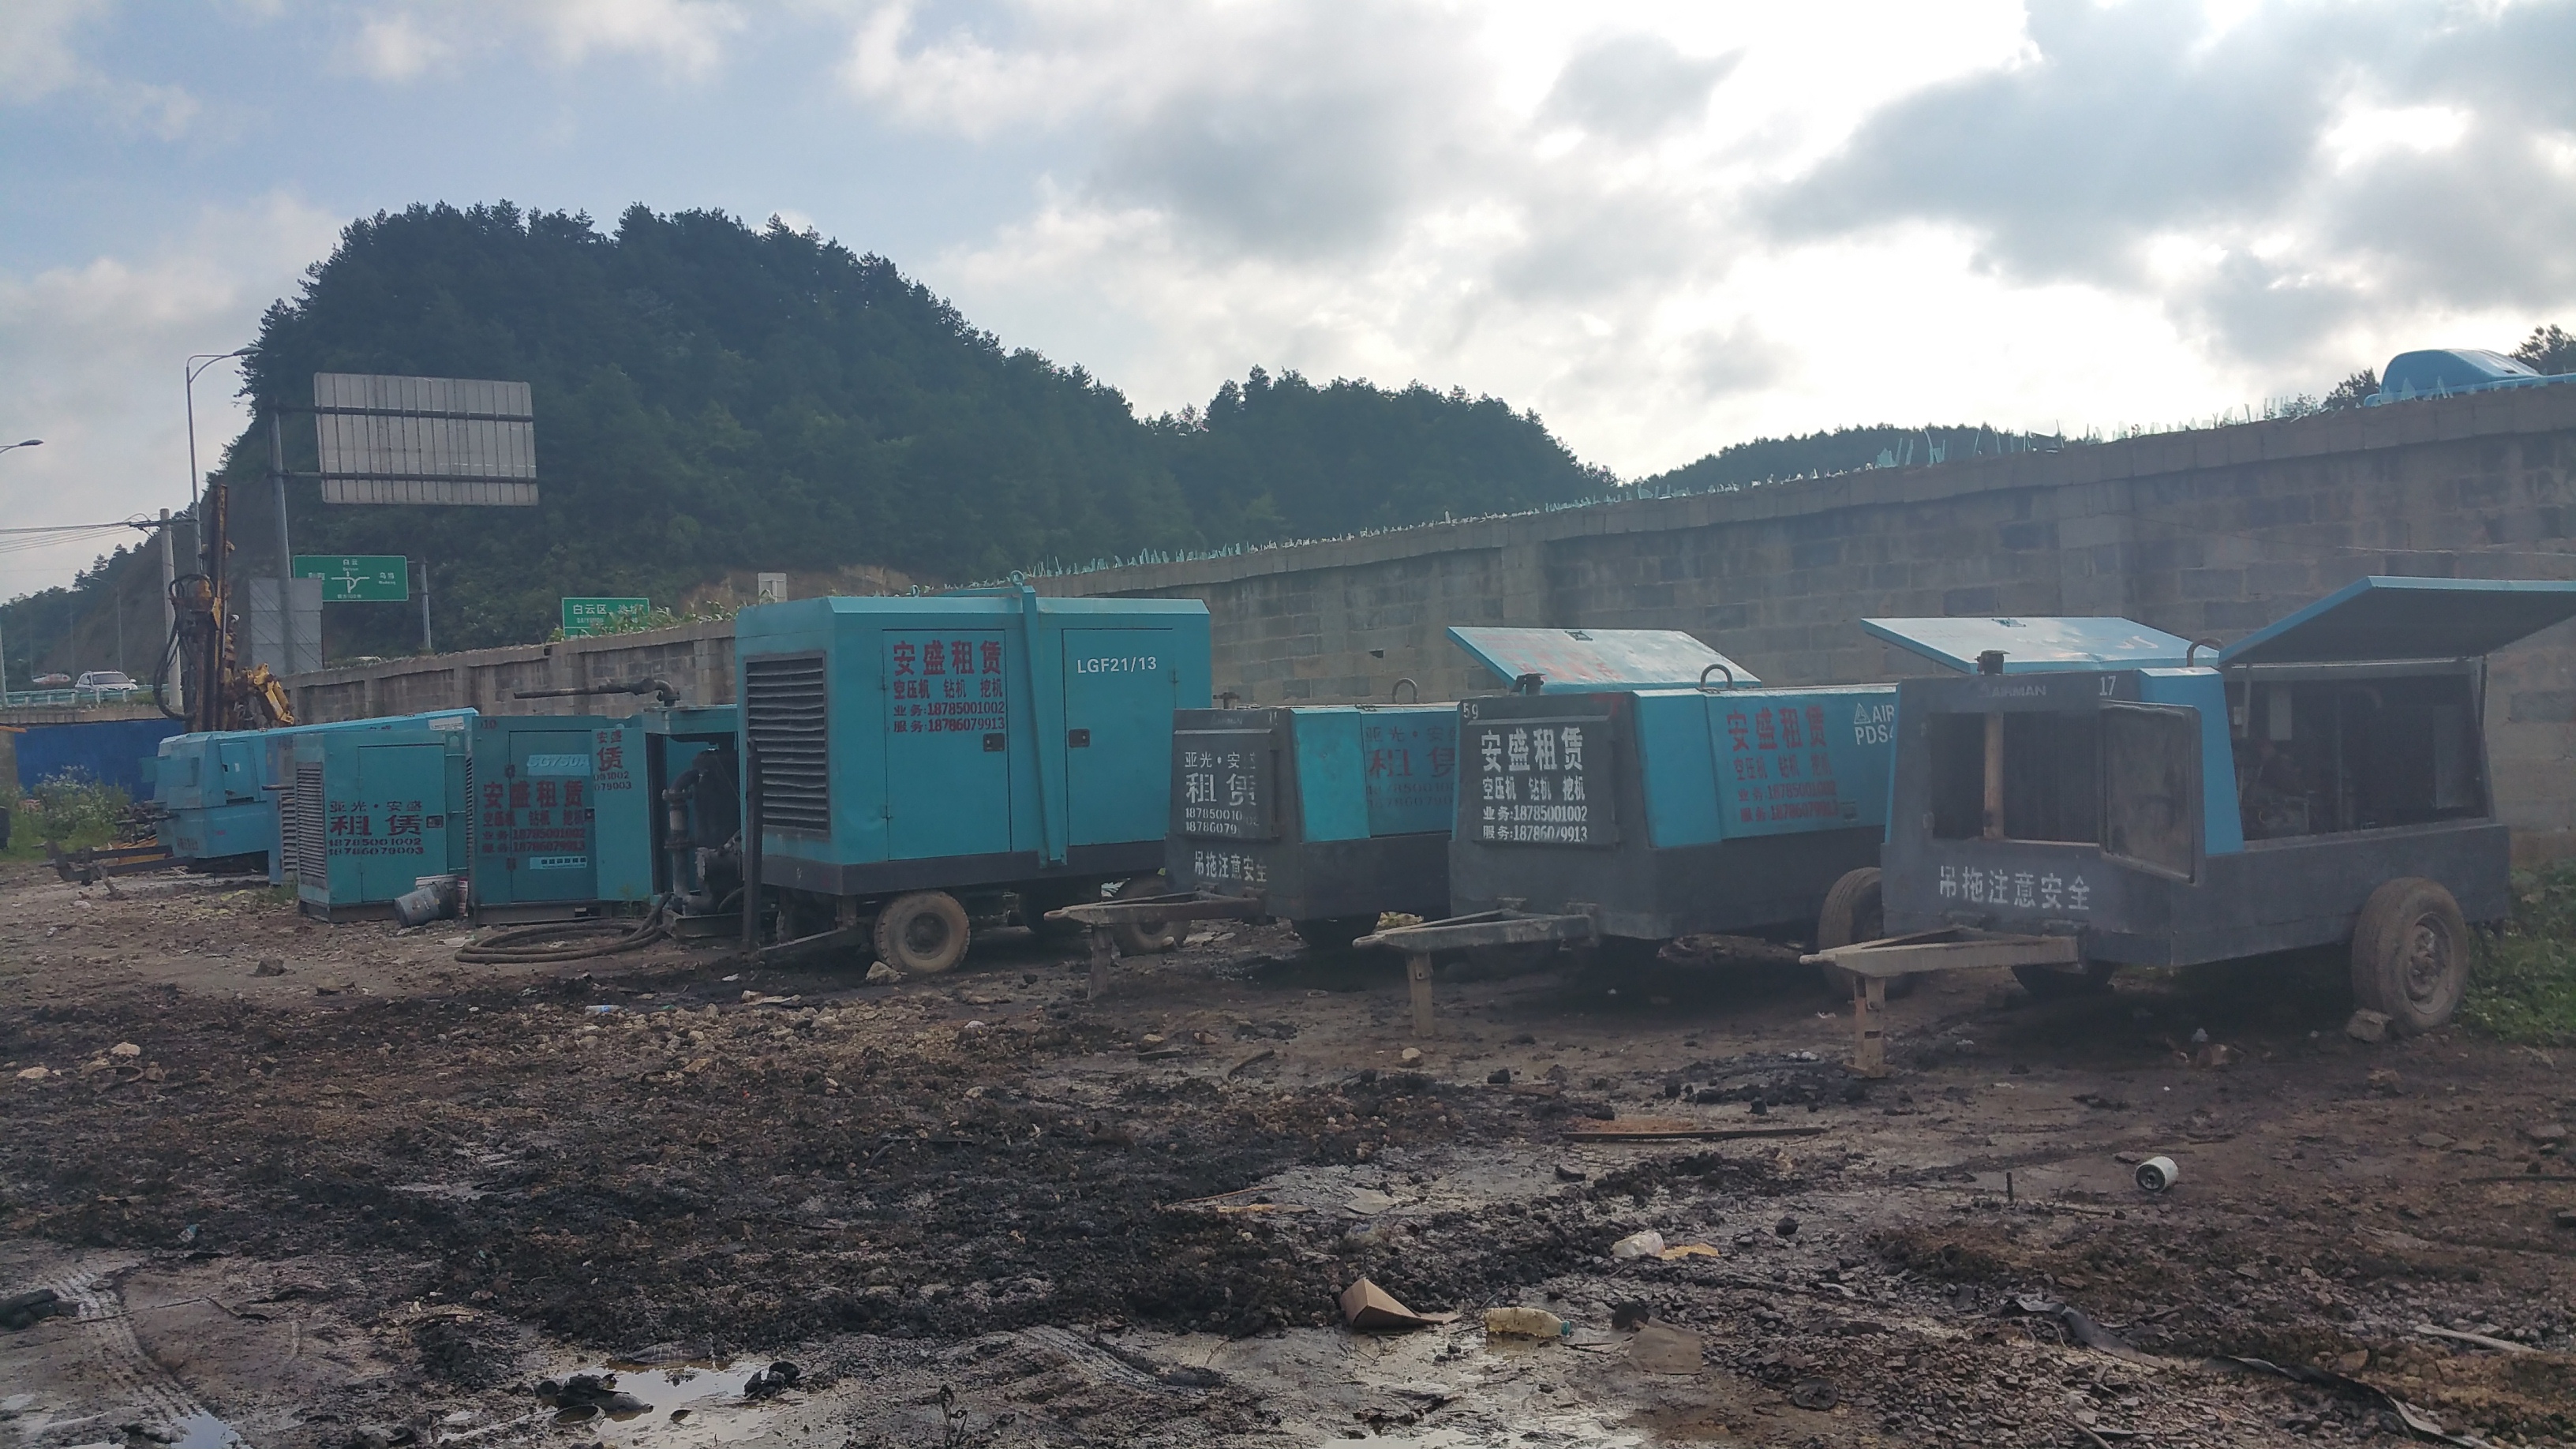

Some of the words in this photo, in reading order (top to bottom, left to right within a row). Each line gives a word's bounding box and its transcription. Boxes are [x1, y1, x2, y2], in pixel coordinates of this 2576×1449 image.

[573, 604, 607, 615] 白云区
[893, 640, 1002, 676] 安盛租赁
[1077, 656, 1157, 674] LGF21/13
[893, 679, 930, 700] 空压机
[943, 679, 967, 698] 钻机
[980, 678, 1003, 698] 挖机
[2099, 676, 2117, 696] 17
[1463, 702, 1479, 720] 59
[1726, 706, 1828, 752] 安盛租赁
[1481, 726, 1584, 773] 安盛租赁
[483, 781, 584, 809] 安盛租赁
[1185, 772, 1257, 806] 租赁
[1482, 776, 1517, 801] 空压机
[1528, 777, 1552, 801] 钻机
[1563, 776, 1586, 801] 挖机
[330, 814, 423, 837] 租赁
[329, 837, 421, 847] 18785001002
[1195, 850, 1267, 882] 吊拖注意安全
[1940, 865, 2090, 911] 吊拖注意安全
